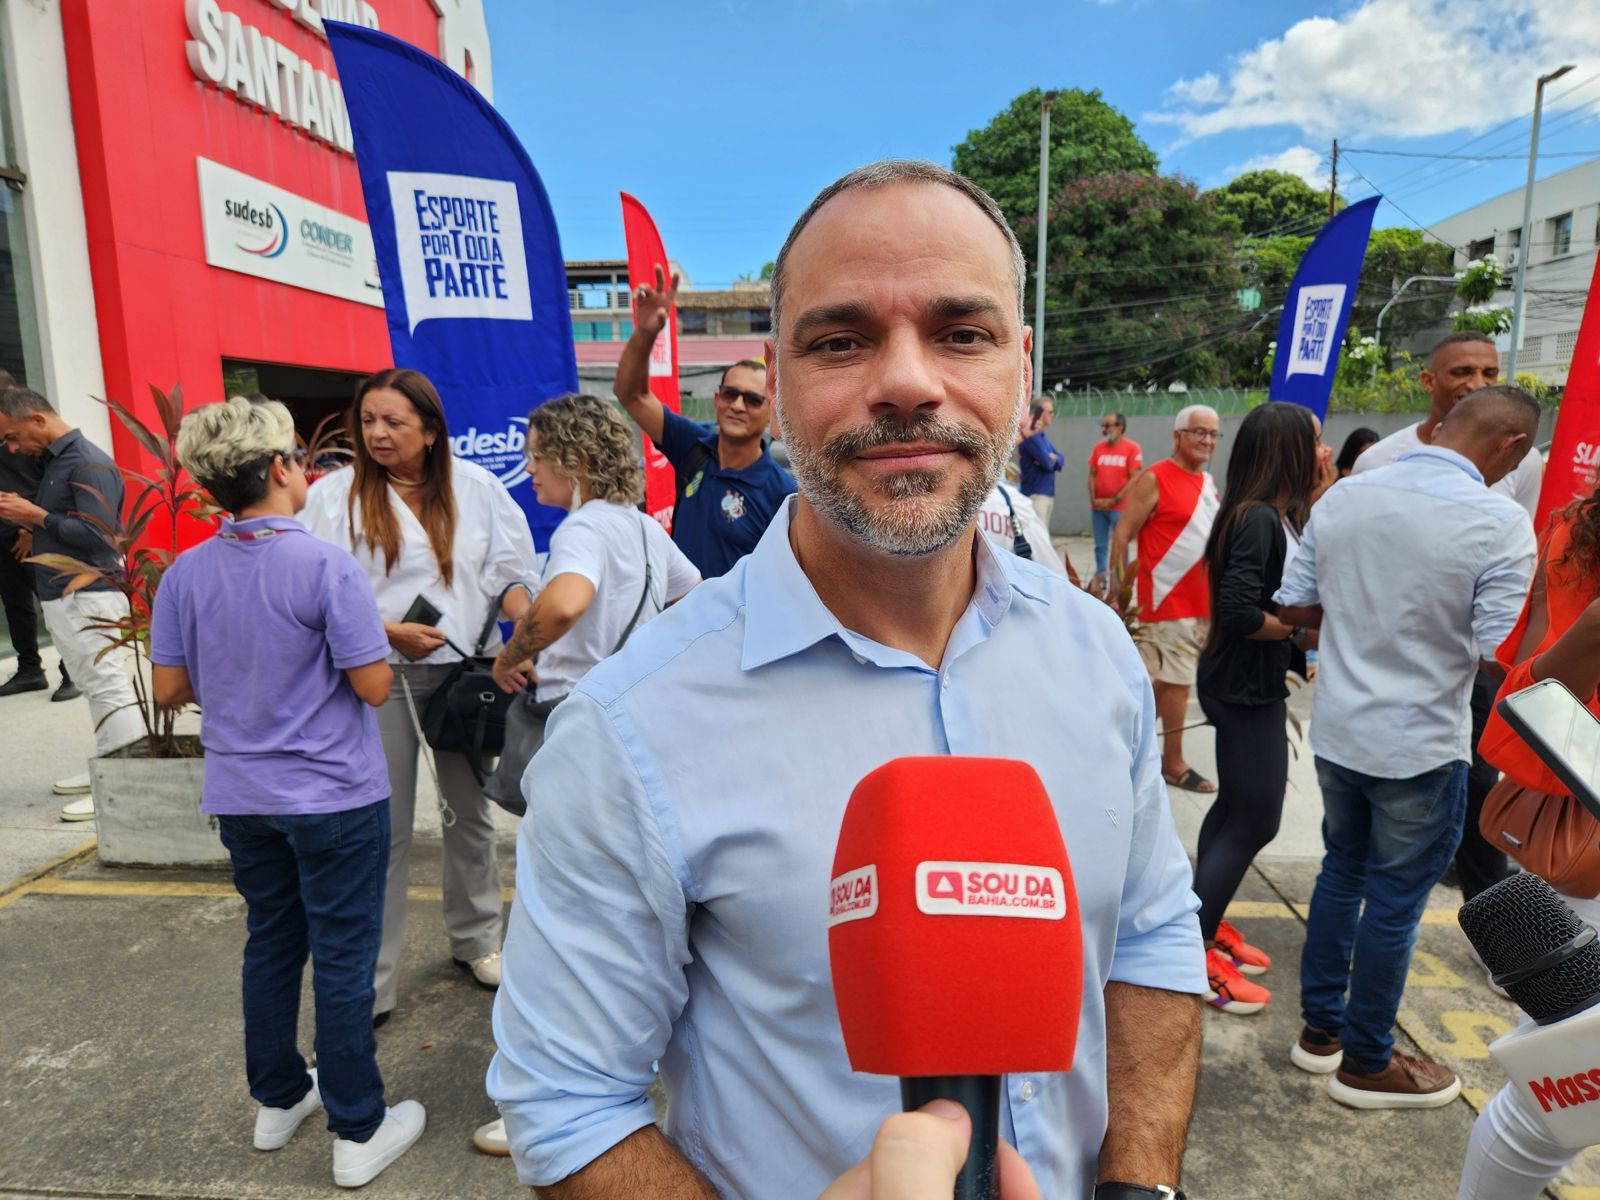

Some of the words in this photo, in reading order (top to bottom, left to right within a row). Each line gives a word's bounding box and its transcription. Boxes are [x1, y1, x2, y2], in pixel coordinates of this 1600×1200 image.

[225, 199, 274, 229] sudesb
[414, 190, 500, 234] ESPORTE
[300, 219, 353, 252] CONDER
[449, 230, 504, 262] TODA
[424, 258, 509, 299] PARTE
[854, 875, 871, 898] DA
[967, 872, 1019, 895] SOU
[1025, 876, 1055, 898] DA
[968, 895, 1057, 910] BAHIA.COM.BR
